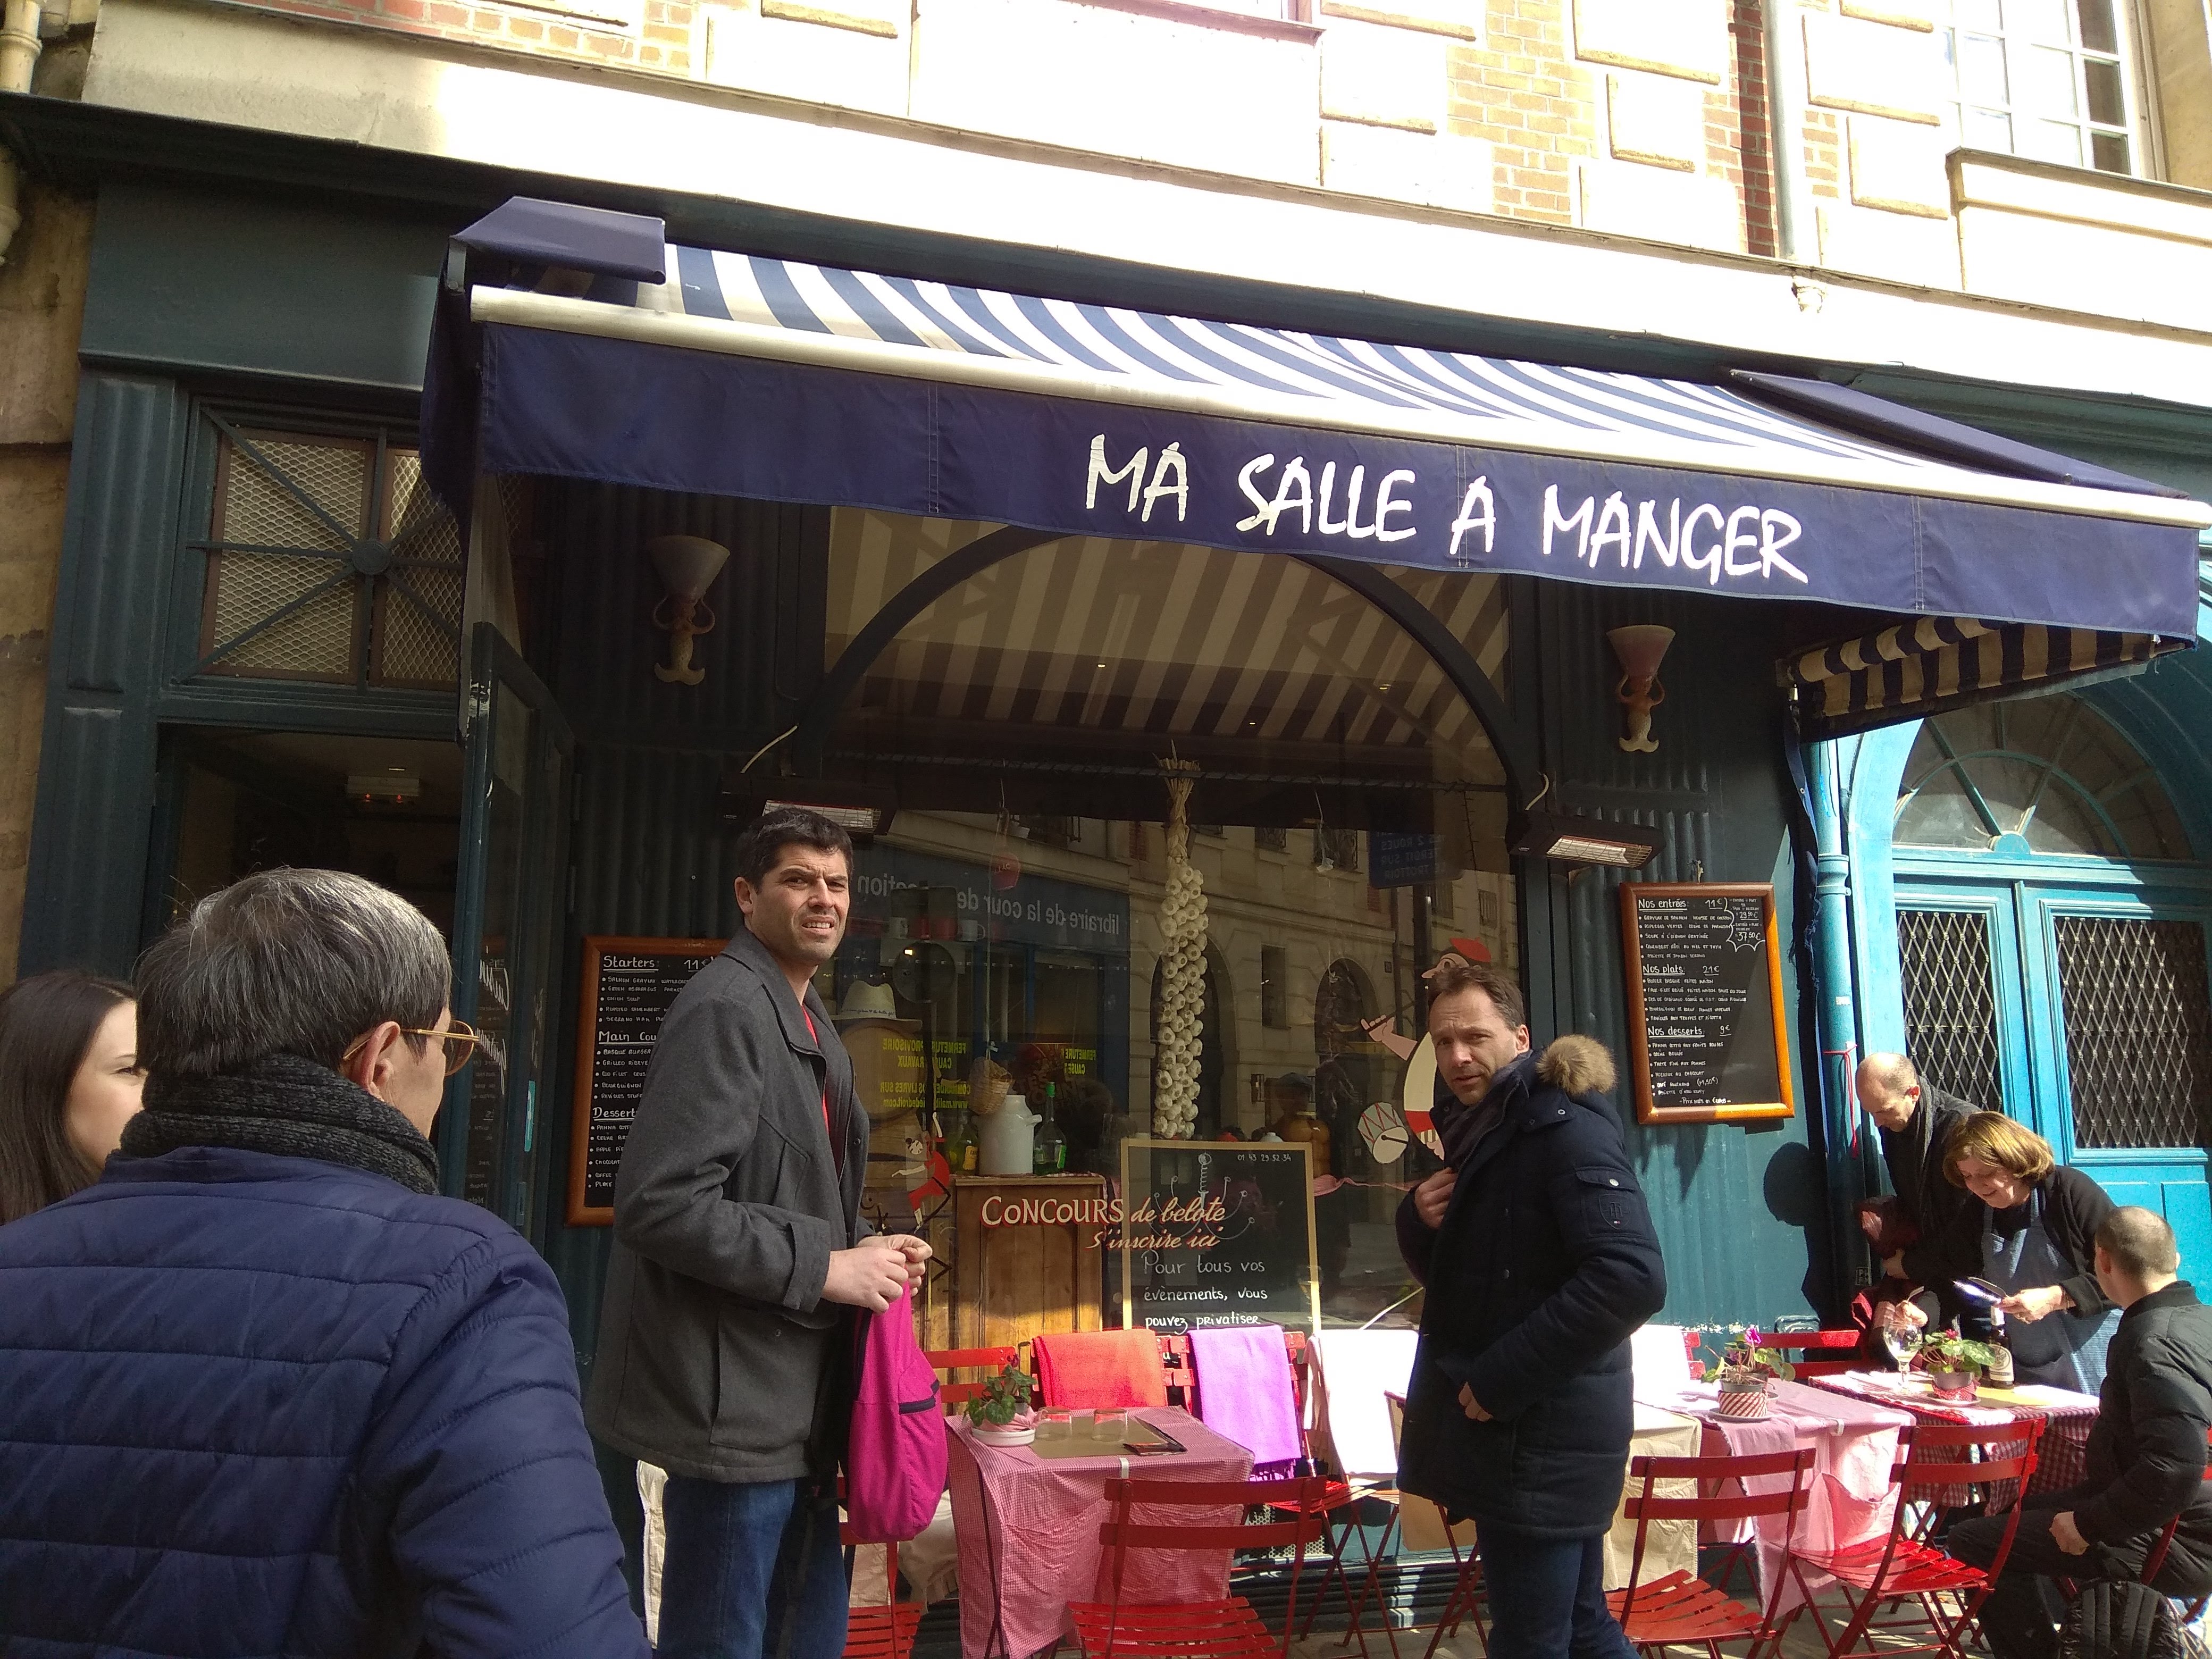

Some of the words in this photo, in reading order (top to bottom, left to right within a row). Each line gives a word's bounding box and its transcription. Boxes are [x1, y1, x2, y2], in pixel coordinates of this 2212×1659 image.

[1086, 433, 1189, 522] MA
[1236, 453, 1417, 541] SALLE
[1449, 475, 1496, 554] A
[1543, 484, 1808, 585] MANGER
[1639, 899, 1655, 908] Nos
[1658, 899, 1687, 908] entrées
[603, 956, 655, 967] Starters
[1643, 964, 1660, 973] Nos
[1663, 964, 1683, 976] plats
[598, 1030, 630, 1042] Main
[1648, 1026, 1664, 1036] Nos
[1668, 1026, 1702, 1035] desserts
[592, 1107, 636, 1119] Dessert
[1131, 1197, 1157, 1223] de
[1161, 1196, 1225, 1224] belote
[1188, 1227, 1224, 1247] ici
[1141, 1250, 1186, 1274] Pour
[1197, 1255, 1231, 1273] tous
[1241, 1261, 1265, 1272] vos
[1238, 1287, 1268, 1299] vous
[1145, 1317, 1188, 1335] pouvez
